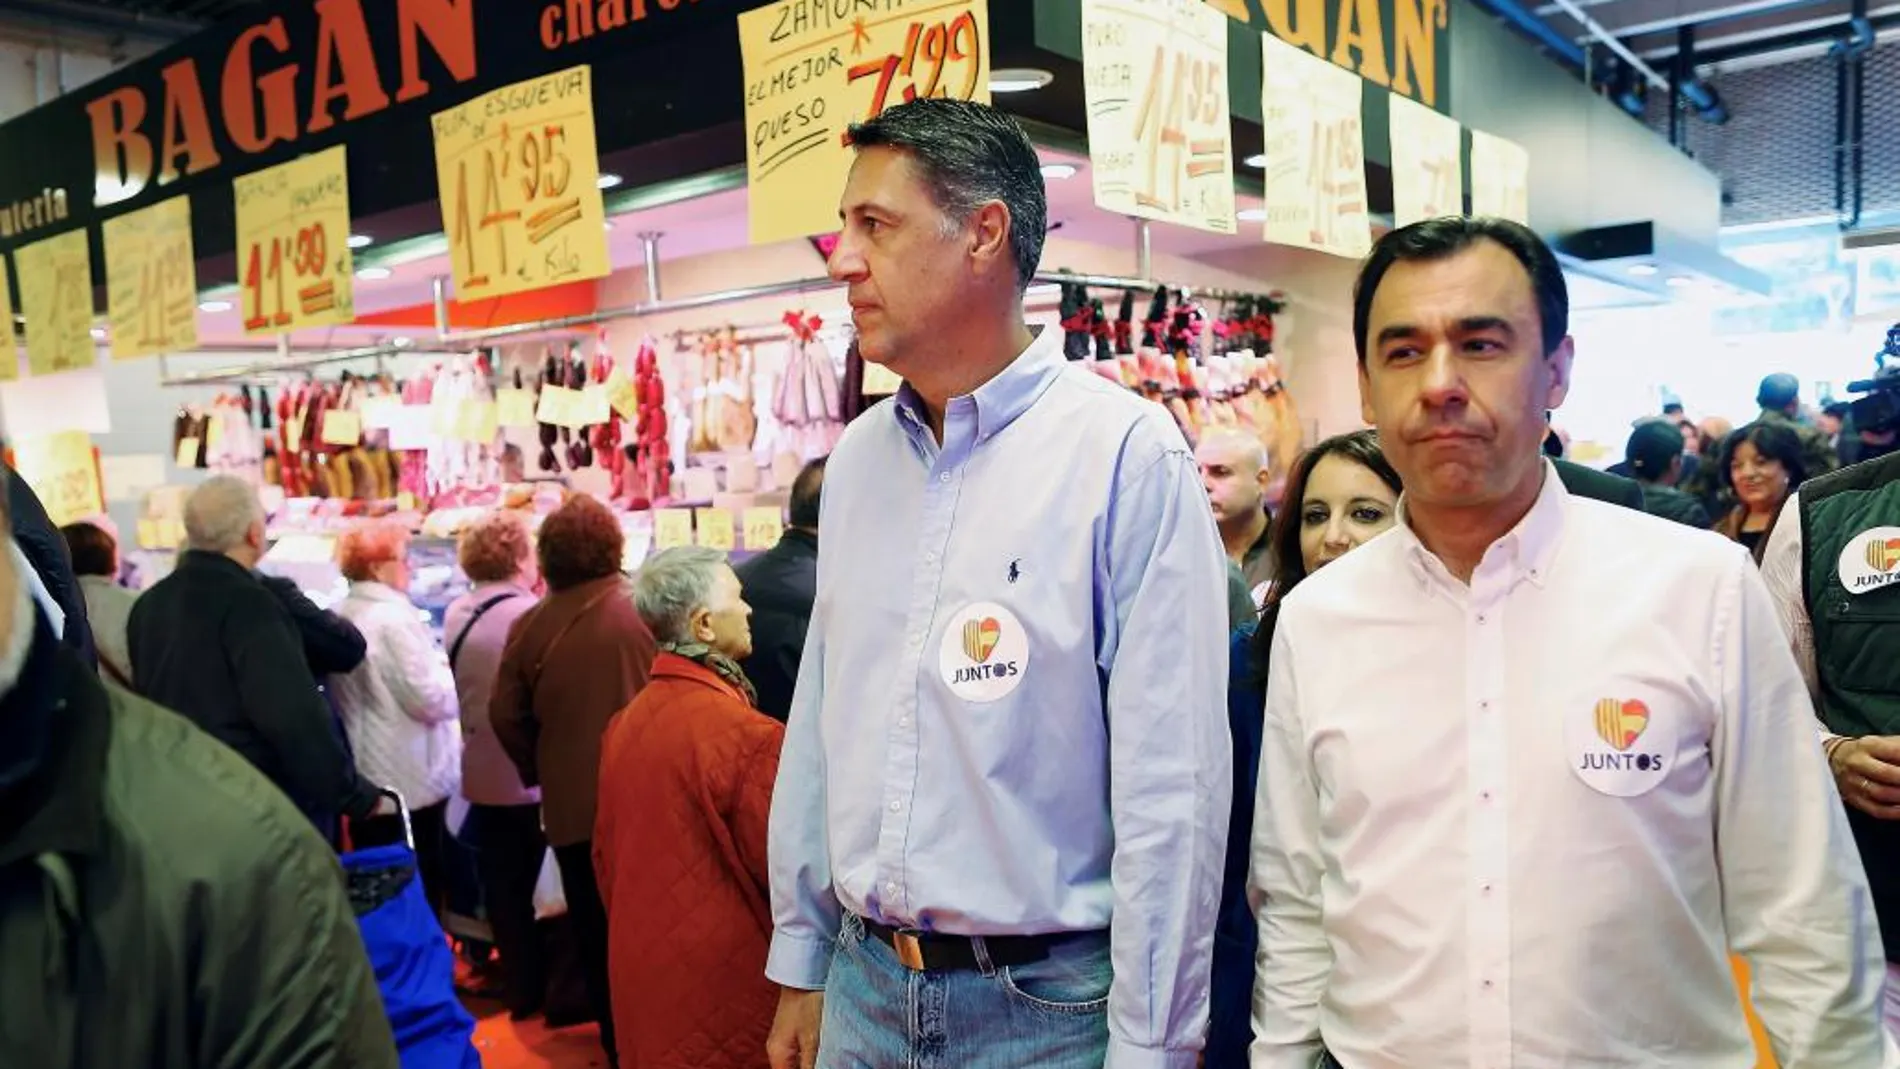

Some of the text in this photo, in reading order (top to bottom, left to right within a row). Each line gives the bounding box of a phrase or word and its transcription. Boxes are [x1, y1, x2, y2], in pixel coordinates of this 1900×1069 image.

[485, 71, 584, 117] ESGUEVA
[754, 97, 826, 155] QUESO
[953, 661, 1018, 684] JUNTOS
[1580, 753, 1662, 771] JUNTOS
